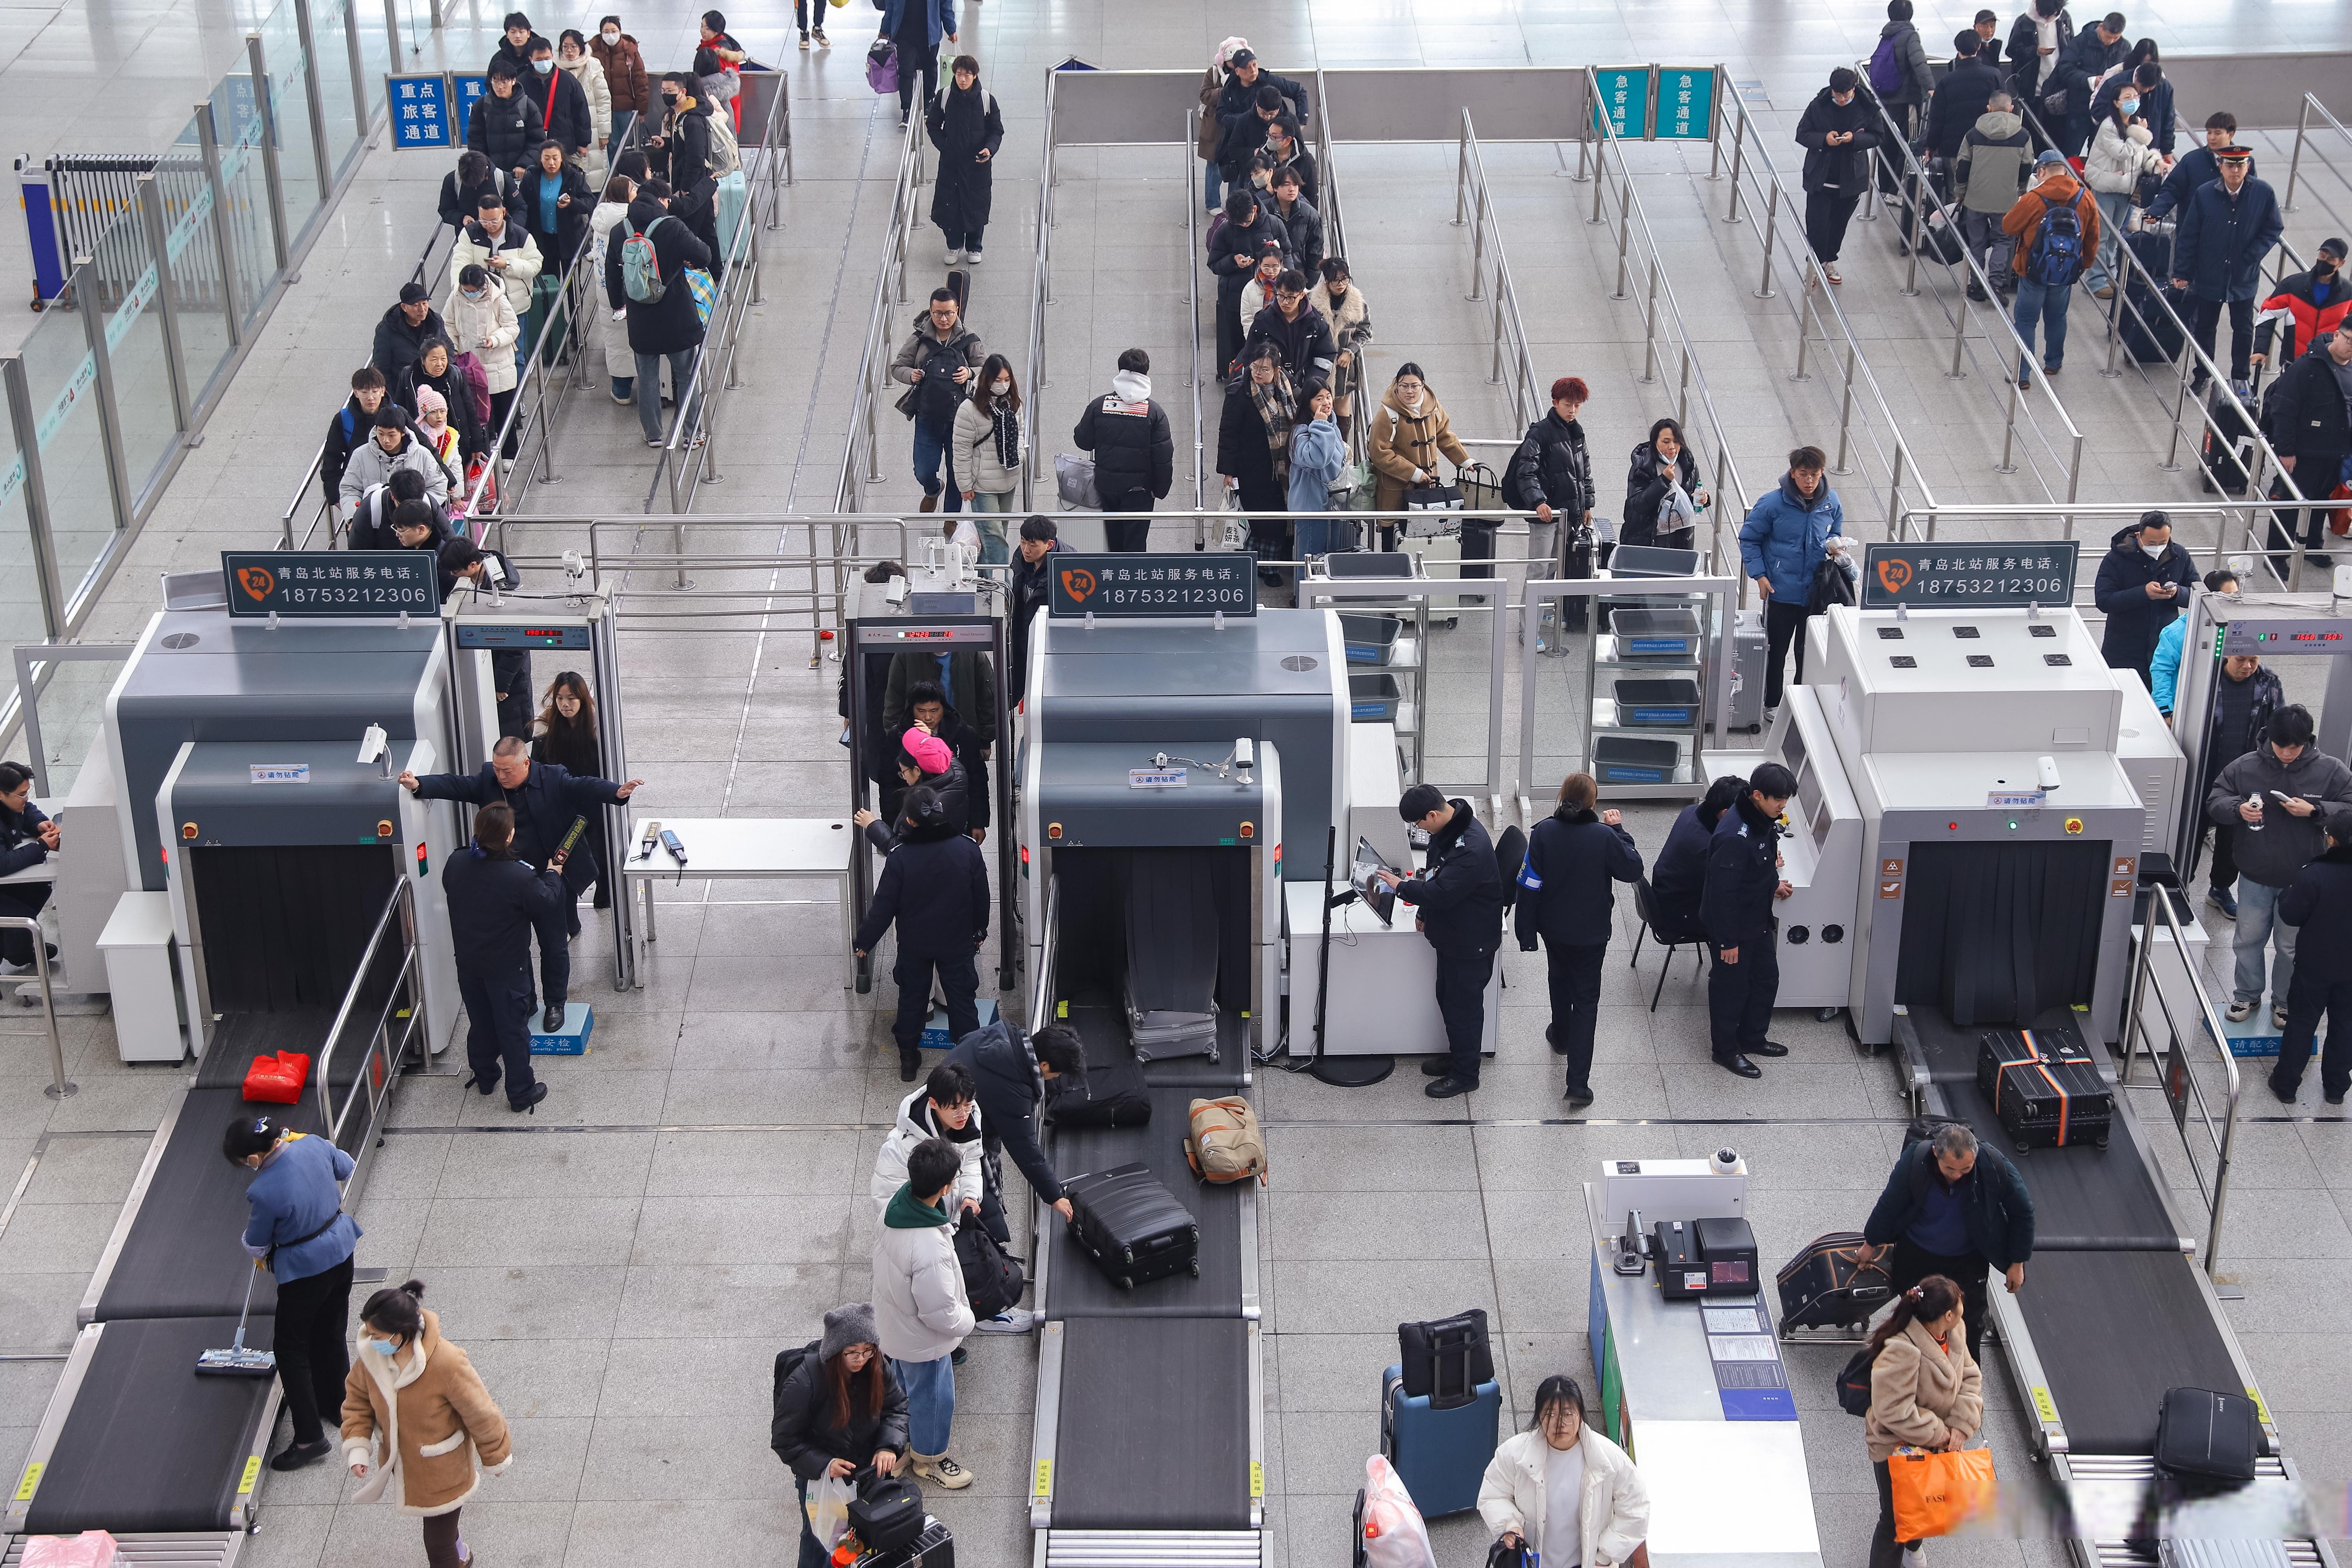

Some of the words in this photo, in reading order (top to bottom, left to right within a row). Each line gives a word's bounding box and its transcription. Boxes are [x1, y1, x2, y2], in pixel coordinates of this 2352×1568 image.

[400, 82, 435, 99] 重点
[402, 103, 437, 120] 旅客
[1613, 74, 1629, 135] 急客通道
[1675, 74, 1692, 135] 急客通道
[404, 123, 440, 140] 通道
[1918, 557, 2059, 572] 青岛北站服务电话：
[278, 567, 420, 579] 青岛北站服务电话：
[1101, 568, 1240, 581] 青岛北站服务电话：
[1890, 568, 1904, 579] 24
[253, 576, 266, 587] 24
[1074, 578, 1087, 589] 24
[1917, 578, 2061, 594] 18753212306
[282, 588, 426, 602] 18753212306
[1102, 589, 1244, 603] 18753212306
[573, 818, 585, 834] SUPER
[563, 830, 578, 850] SCANNER
[530, 1038, 571, 1047] 合安检
[2234, 1039, 2277, 1049] 请配合
[1039, 1465, 1047, 1489] 禁止踩踏
